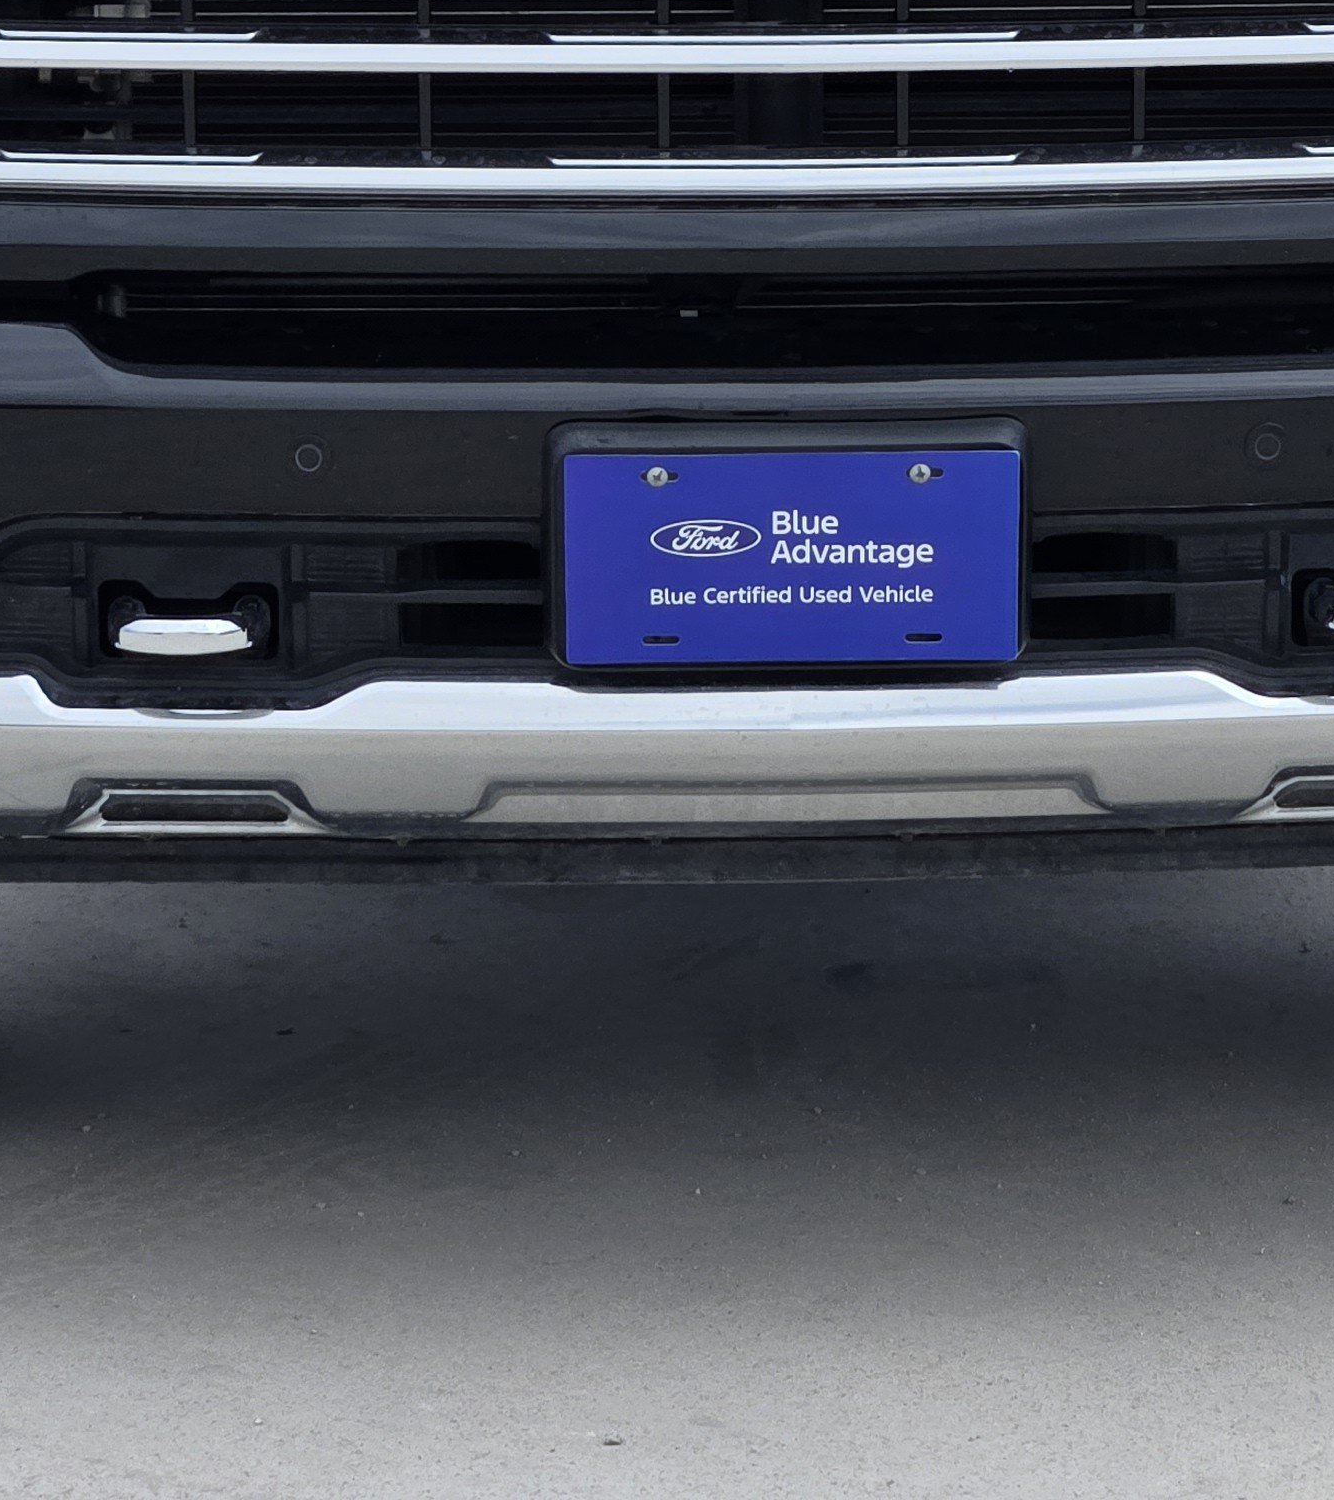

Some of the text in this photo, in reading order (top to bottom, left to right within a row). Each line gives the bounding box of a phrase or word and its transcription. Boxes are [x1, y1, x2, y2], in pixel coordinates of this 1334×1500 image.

[771, 509, 839, 536] Blue
[671, 524, 741, 552] Ford
[770, 539, 934, 569] Advantage
[649, 584, 934, 606] Blue Certified Used Vehicle
